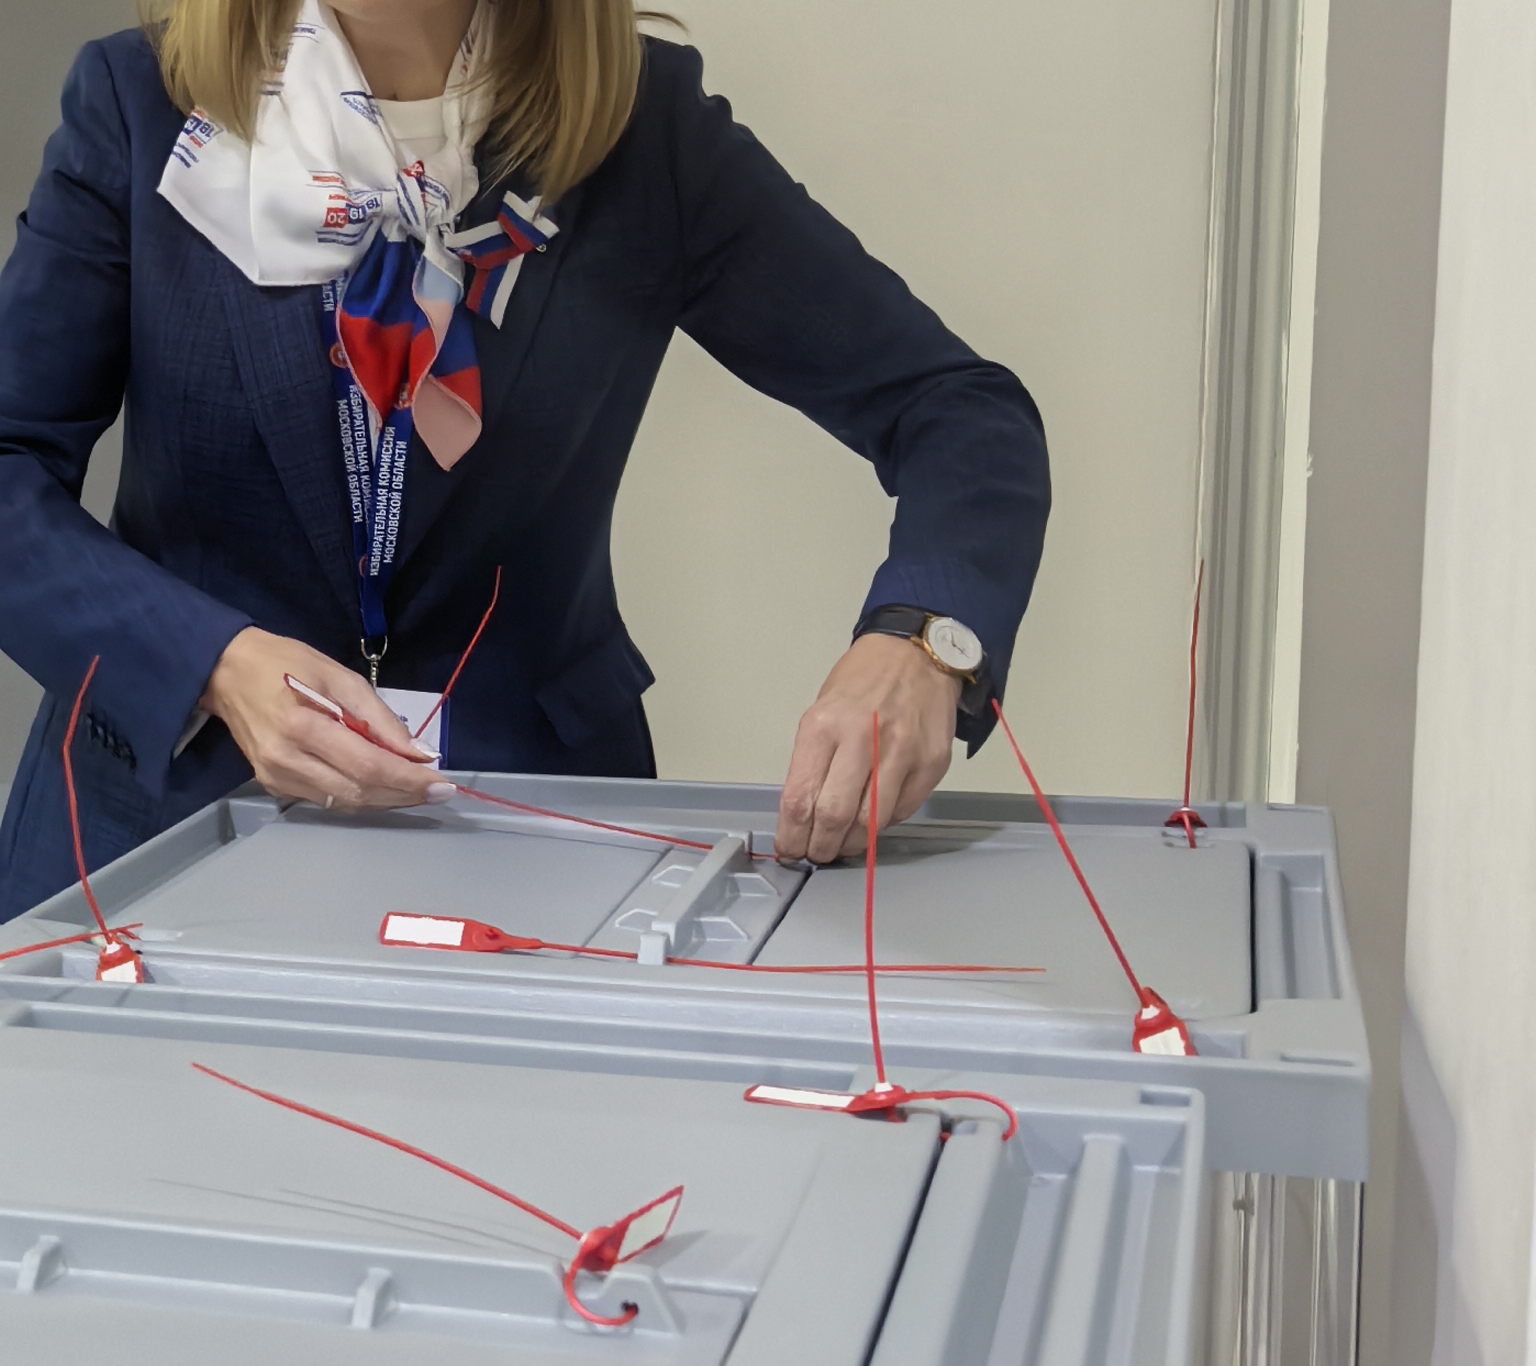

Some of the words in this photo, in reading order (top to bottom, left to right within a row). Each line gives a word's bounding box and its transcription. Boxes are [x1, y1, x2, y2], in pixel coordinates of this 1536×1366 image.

[327, 212, 347, 224] 20
[337, 399, 359, 472] МОСКОВСКОЙ
[348, 474, 363, 523] ОБЛАСТИ
[378, 426, 396, 486] КОМИССИЯ
[392, 440, 407, 490] ОБЛАСТИ
[370, 488, 389, 576] ИЗБИРАТЕЛЬНАЯ
[383, 492, 402, 563] МОСКОВСКОЙ
